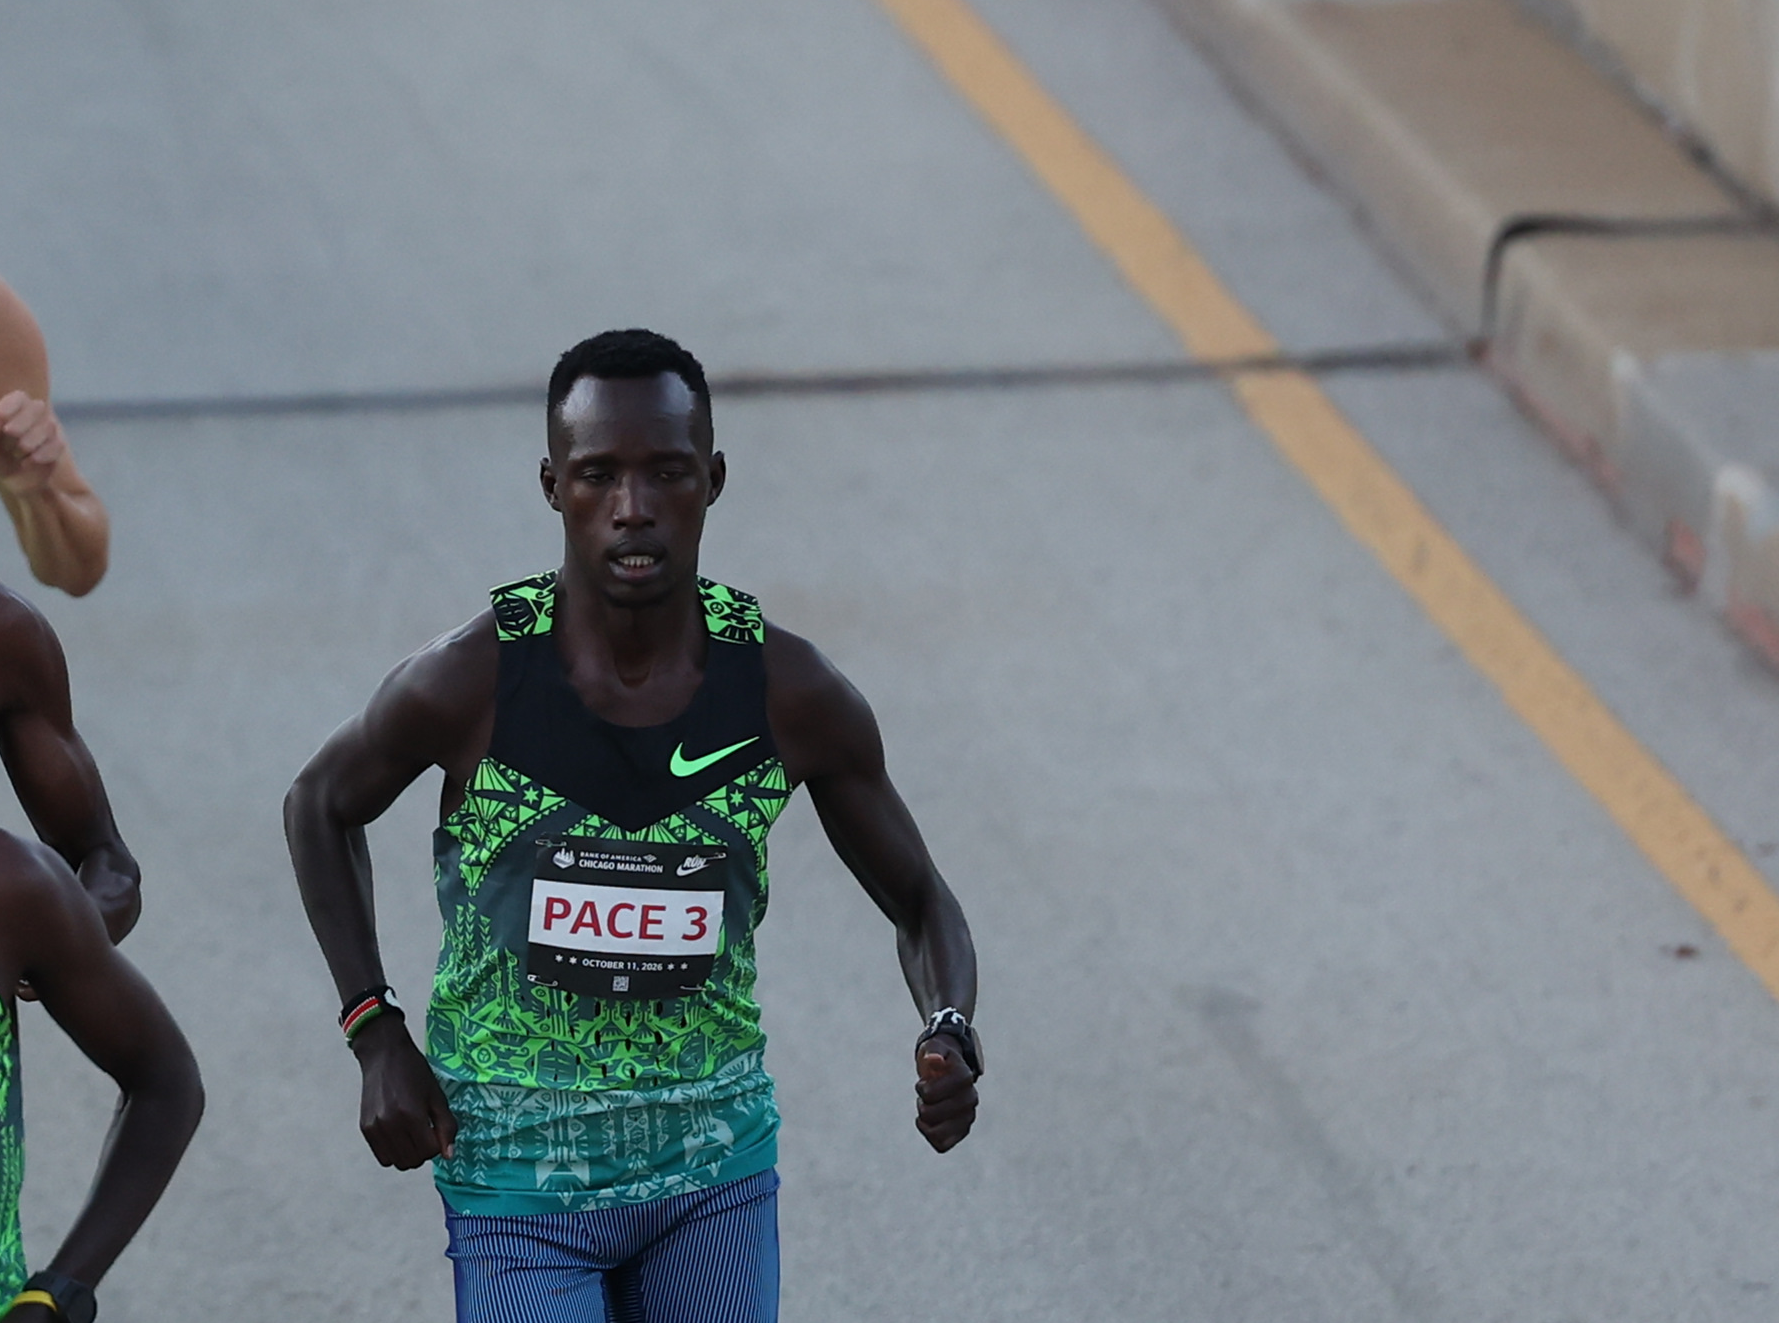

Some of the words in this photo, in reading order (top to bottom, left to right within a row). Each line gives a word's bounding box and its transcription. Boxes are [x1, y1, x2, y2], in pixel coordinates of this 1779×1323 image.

[610, 854, 642, 862] AMERICA
[579, 859, 615, 870] CHICAGO
[617, 862, 663, 873] MARATHON
[543, 897, 667, 940] PACE
[681, 906, 708, 941] 3
[582, 958, 624, 969] OCTOBER
[627, 962, 639, 971] 11,
[641, 963, 663, 971] 2026
